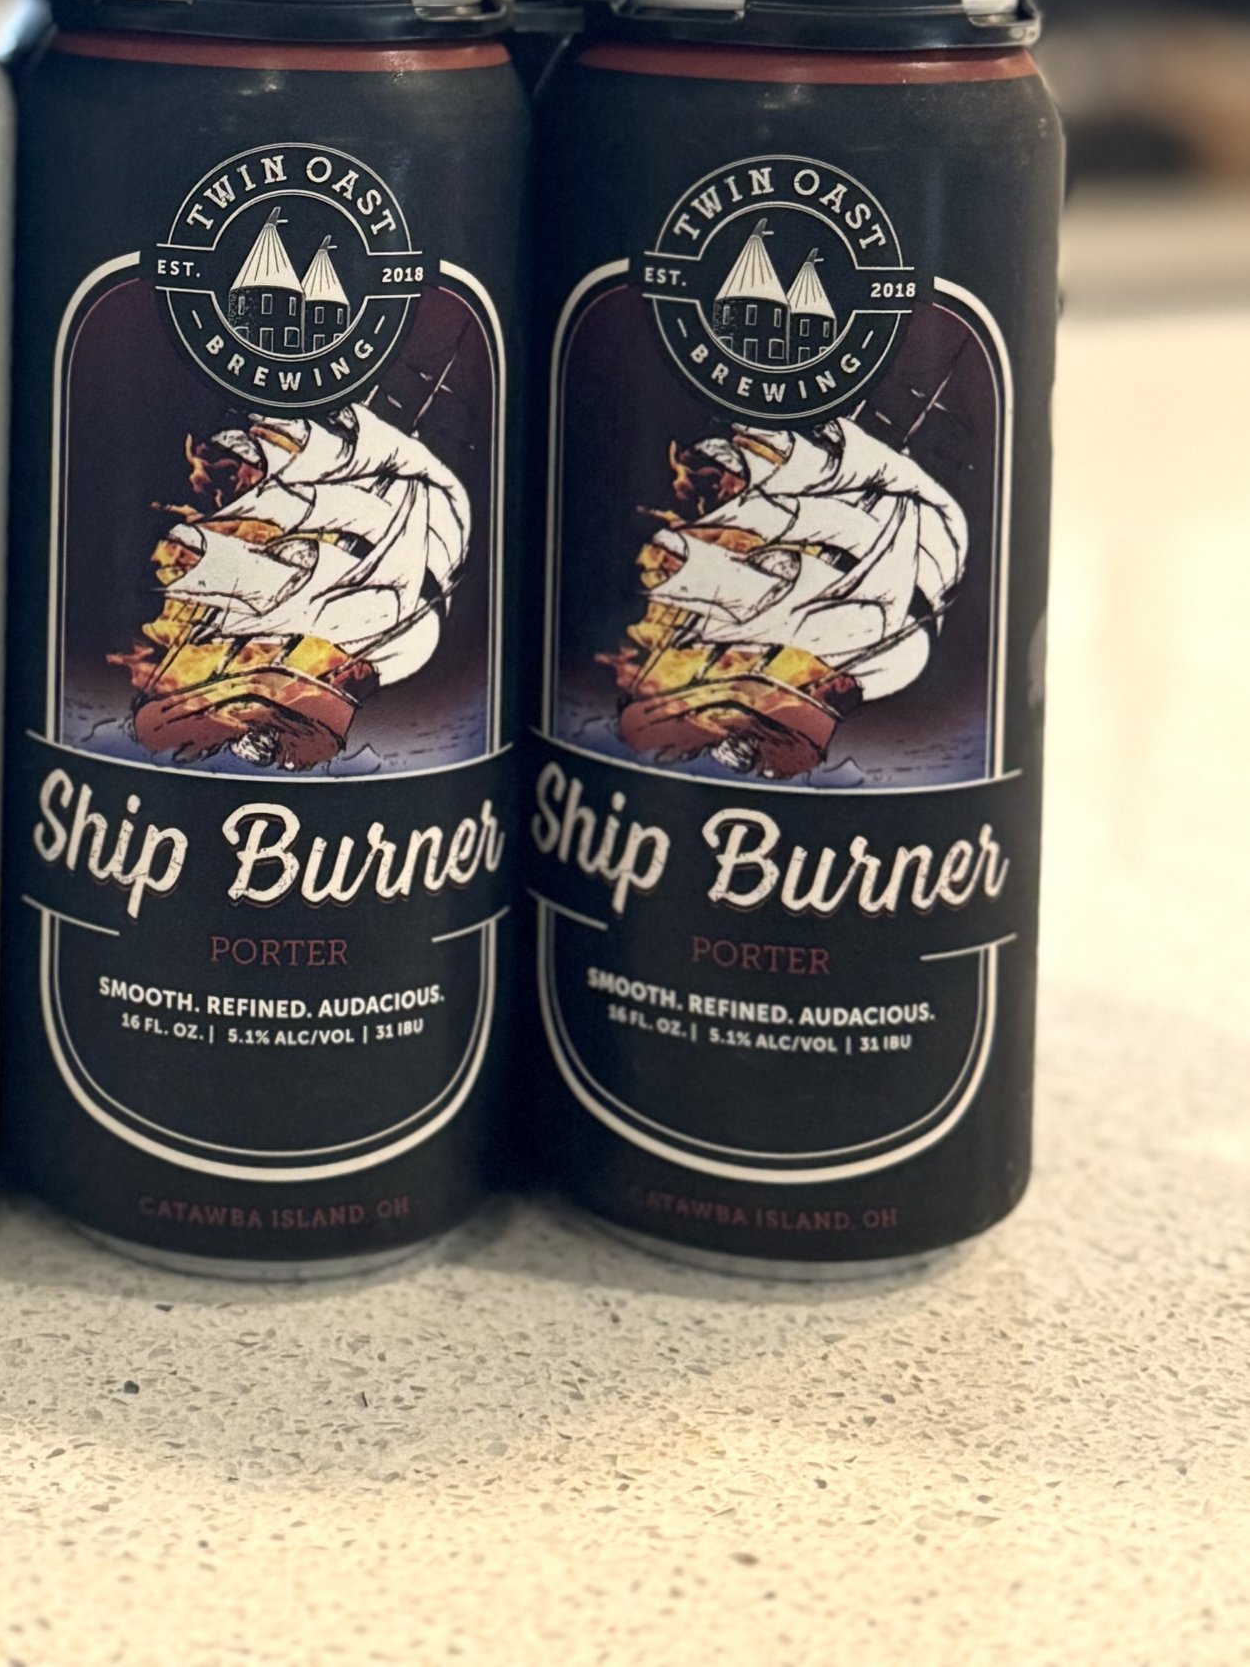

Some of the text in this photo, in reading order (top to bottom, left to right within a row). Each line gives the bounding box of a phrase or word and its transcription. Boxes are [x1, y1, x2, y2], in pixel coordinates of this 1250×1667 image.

[186, 155, 396, 235] TWIN OAST
[673, 167, 886, 250] TWIN OAST
[157, 259, 424, 283] EST. 2018
[644, 267, 916, 298] EST. 2018
[206, 335, 374, 391] BREWING
[690, 344, 862, 403] BREWING
[34, 768, 505, 920] Ship Burner
[531, 762, 1009, 914] Ship Burner
[210, 936, 348, 966] PORTER
[692, 936, 830, 975] PORTER
[99, 976, 445, 1019] SMOOTH. REFINED. AUDACIOUS.
[587, 966, 935, 1026] SMOOTH. REFINED. AUDACIOUS.
[121, 1013, 424, 1045] 16 FL. OZ. 5.1% ALC/VOL 31 IBU
[608, 1004, 912, 1052] 16 FL. OZ. 5.1% ALC/VOL 31 IBU
[138, 1196, 263, 1228] CATAWBA
[376, 1196, 410, 1219] OH
[862, 1207, 898, 1228] OH
